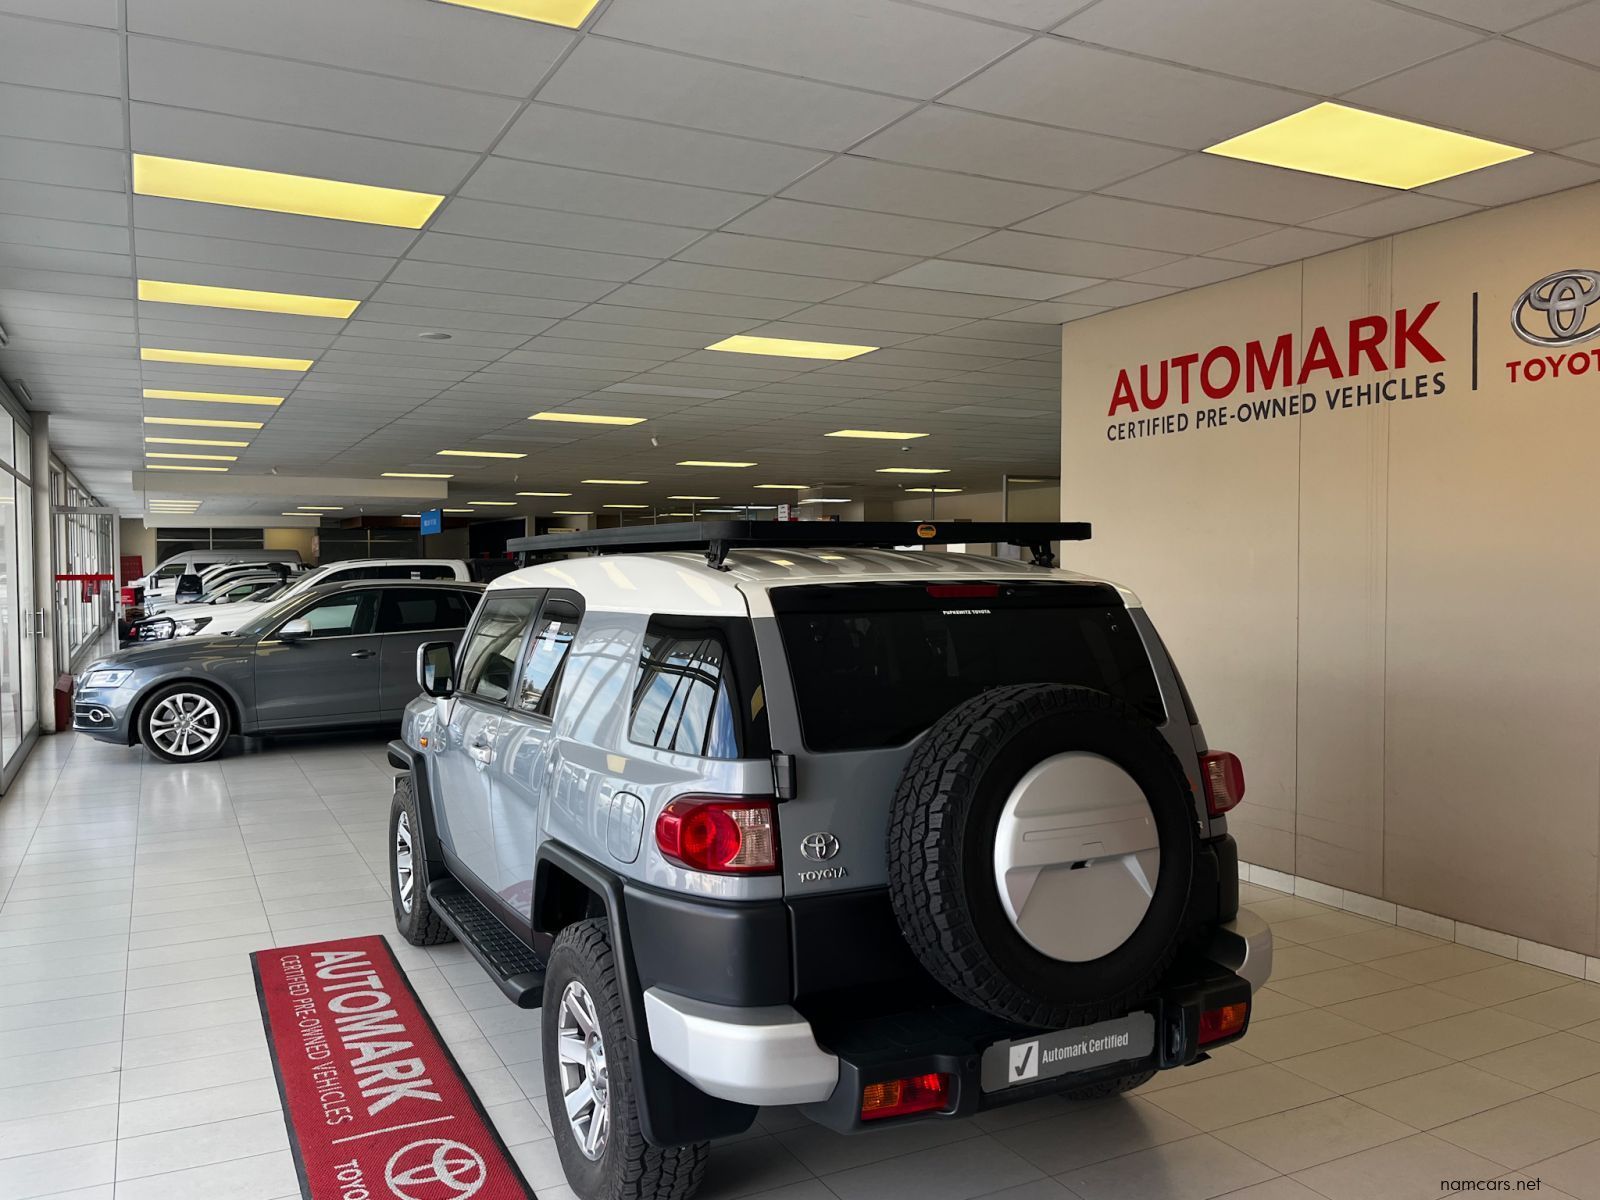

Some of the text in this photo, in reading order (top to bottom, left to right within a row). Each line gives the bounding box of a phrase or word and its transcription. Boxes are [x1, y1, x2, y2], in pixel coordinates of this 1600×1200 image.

[1108, 301, 1446, 416] AUTOMARK
[1107, 372, 1446, 441] CERTIFIED PRE-OWNED VEHICLES
[797, 866, 848, 883] TOYOTA
[280, 954, 353, 1126] CERTIFIED PRE-OWNED VEHICLES
[310, 951, 443, 1117] AUTOMARK
[1042, 1032, 1129, 1064] Automark Certified
[333, 1158, 371, 1200] TOYO
